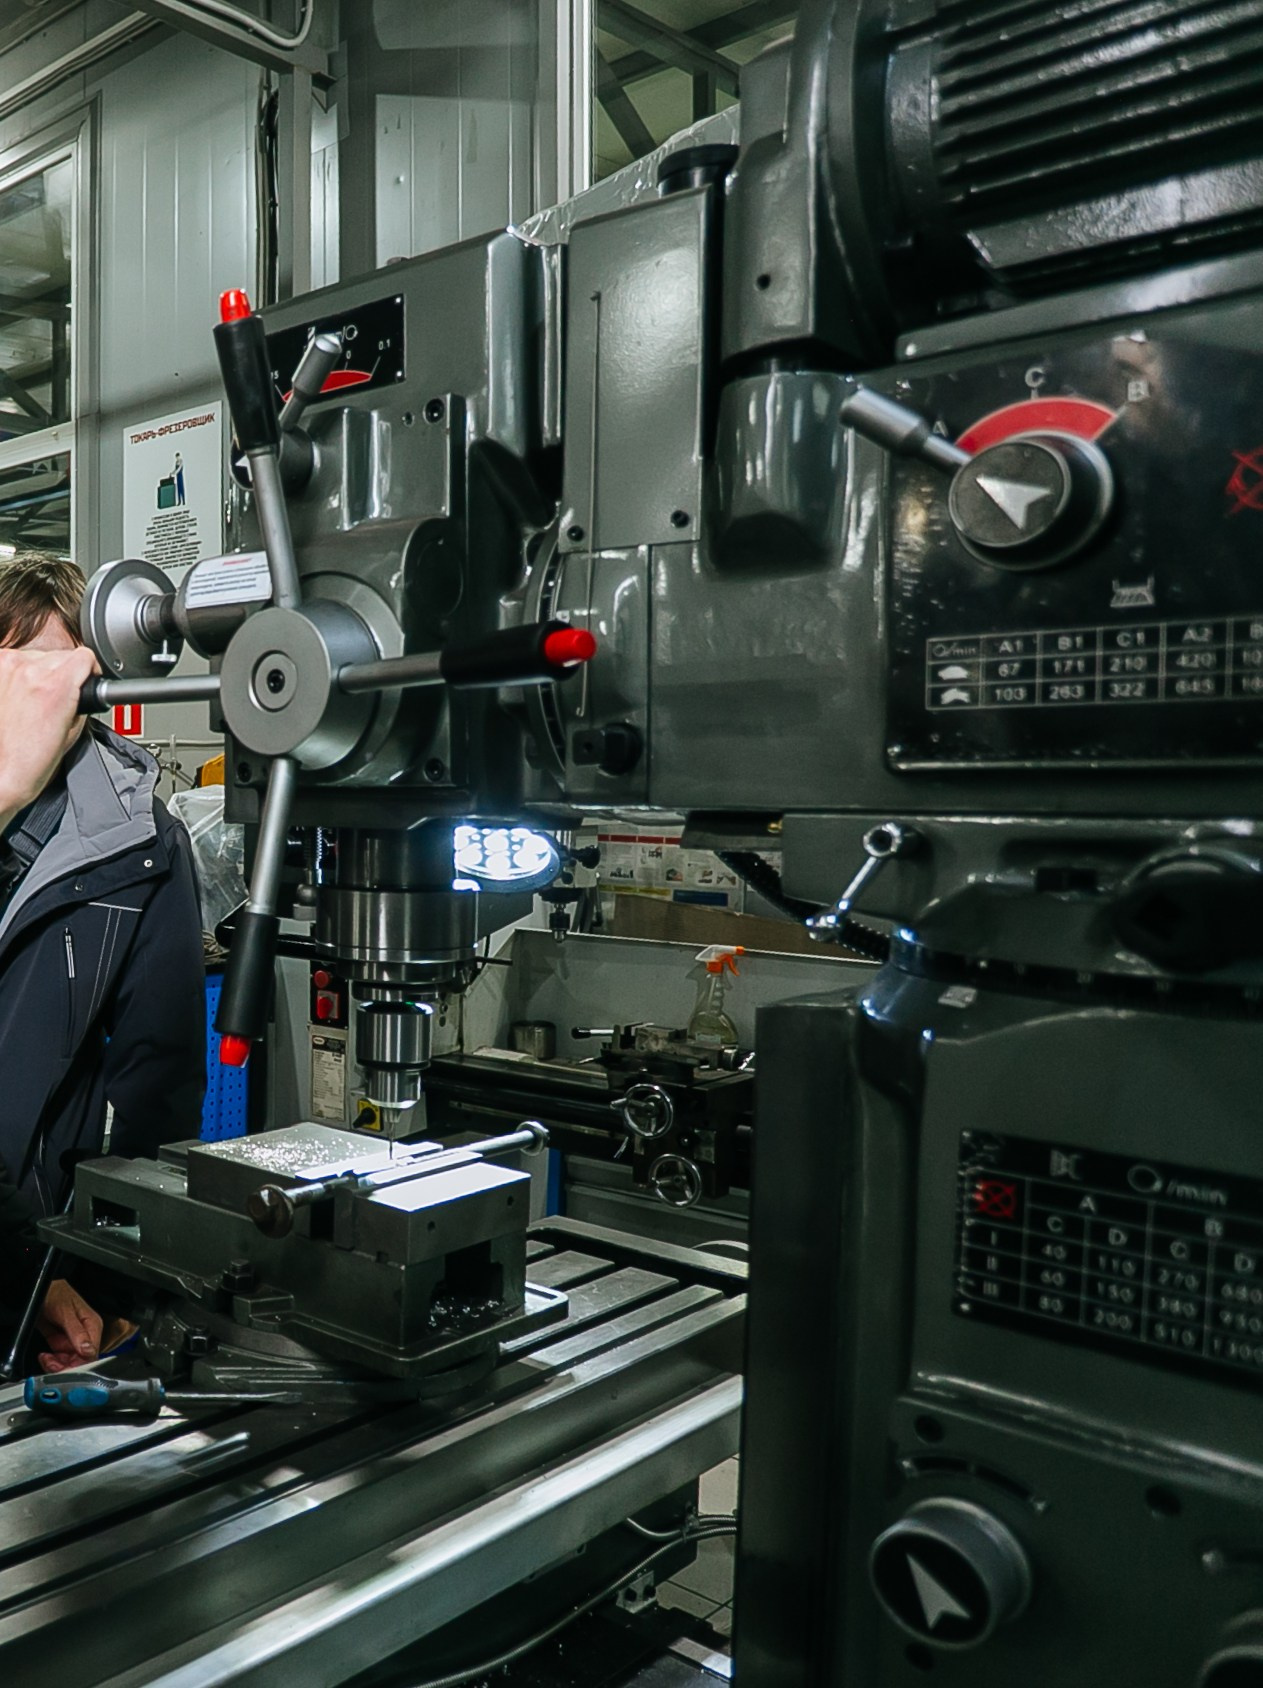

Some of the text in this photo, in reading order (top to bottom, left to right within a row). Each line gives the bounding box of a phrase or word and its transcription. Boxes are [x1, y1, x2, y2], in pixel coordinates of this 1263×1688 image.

[345, 350, 352, 360] 0
[378, 339, 391, 351] 0.1
[1024, 366, 1046, 388] C
[1127, 379, 1149, 402] B
[129, 412, 216, 445] ТОКАРЬ-ФРЕЗЕРОВЩИК
[998, 639, 1024, 653] A1
[1057, 635, 1084, 651] B1
[1116, 631, 1145, 647] C1
[998, 662, 1021, 677] 67
[1053, 659, 1085, 674] 171
[1109, 656, 1147, 673] 210
[994, 687, 1027, 701] 103
[1109, 682, 1146, 698] 322
[1079, 1195, 1097, 1214] A
[1046, 1215, 1256, 1274] C D C D
[1041, 1243, 1067, 1261] 40
[1098, 1254, 1135, 1276] 110
[1093, 1308, 1134, 1331] 200
